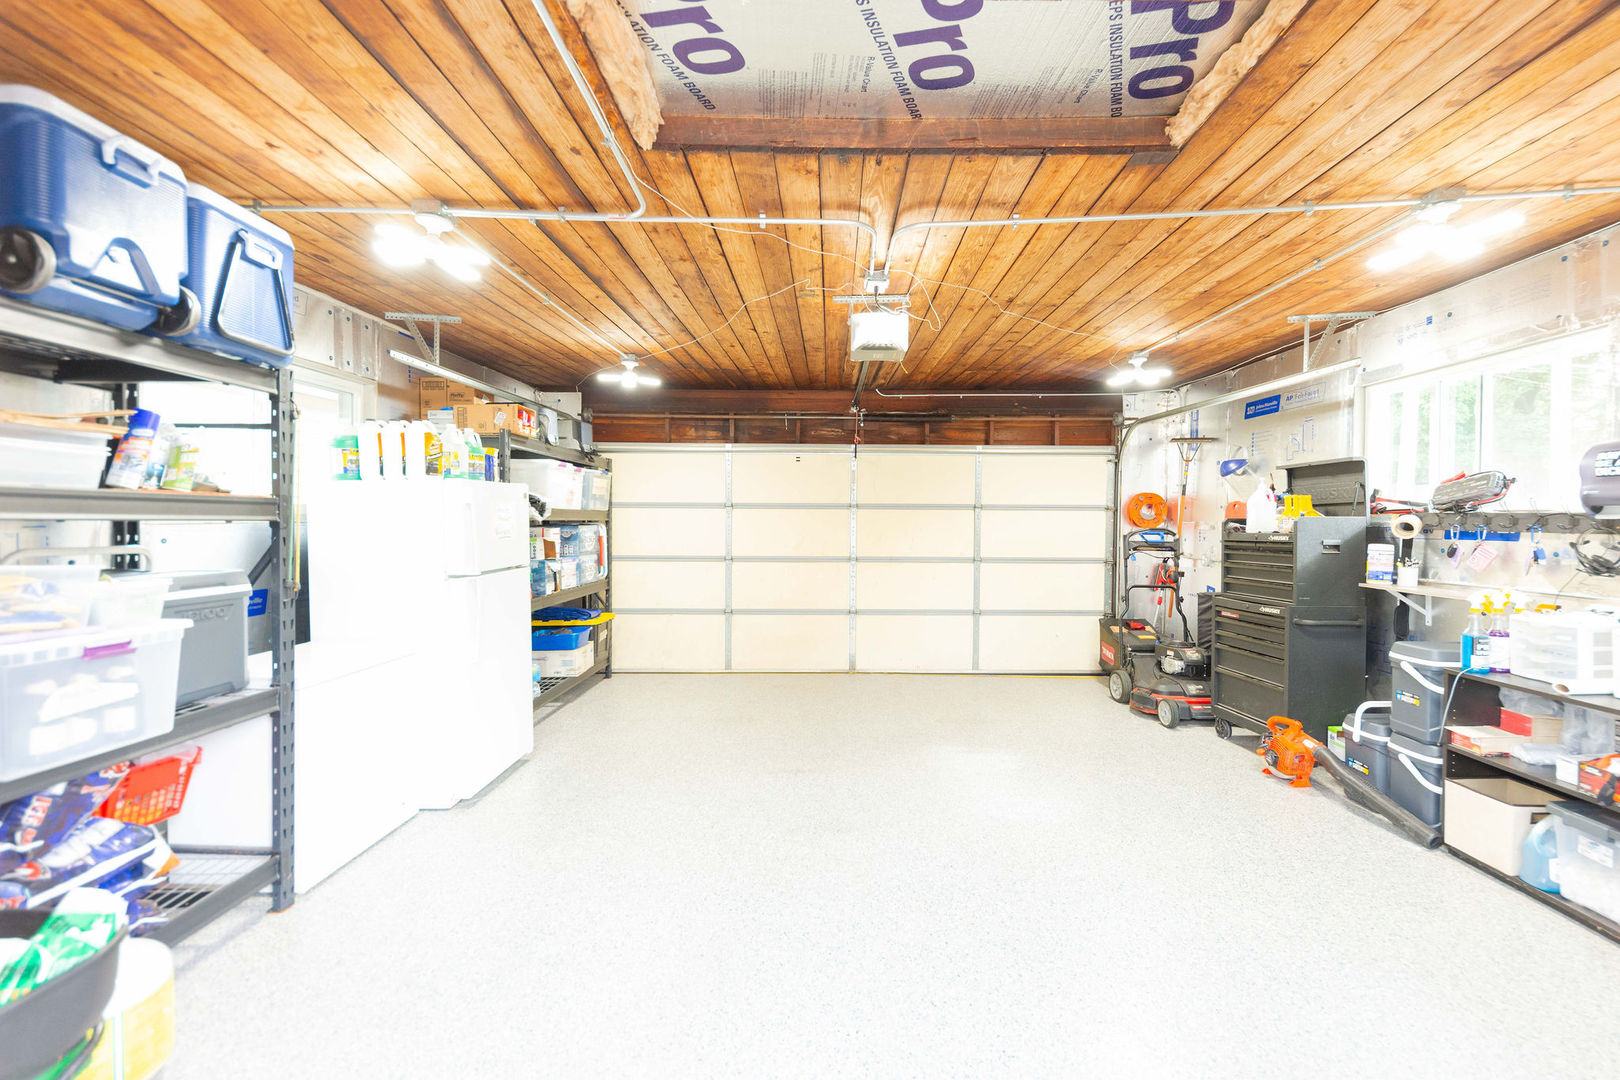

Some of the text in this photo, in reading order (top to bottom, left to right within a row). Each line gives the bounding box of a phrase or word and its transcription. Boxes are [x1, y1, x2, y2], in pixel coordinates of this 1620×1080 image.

[860, 8, 900, 70] INSULATION
[890, 71, 912, 97] FOAM
[1109, 23, 1123, 81] INSULATION
[1127, 0, 1236, 100] Pro
[656, 53, 689, 81] FOAM
[683, 81, 716, 111] BOARD
[1110, 83, 1123, 106] FOAM
